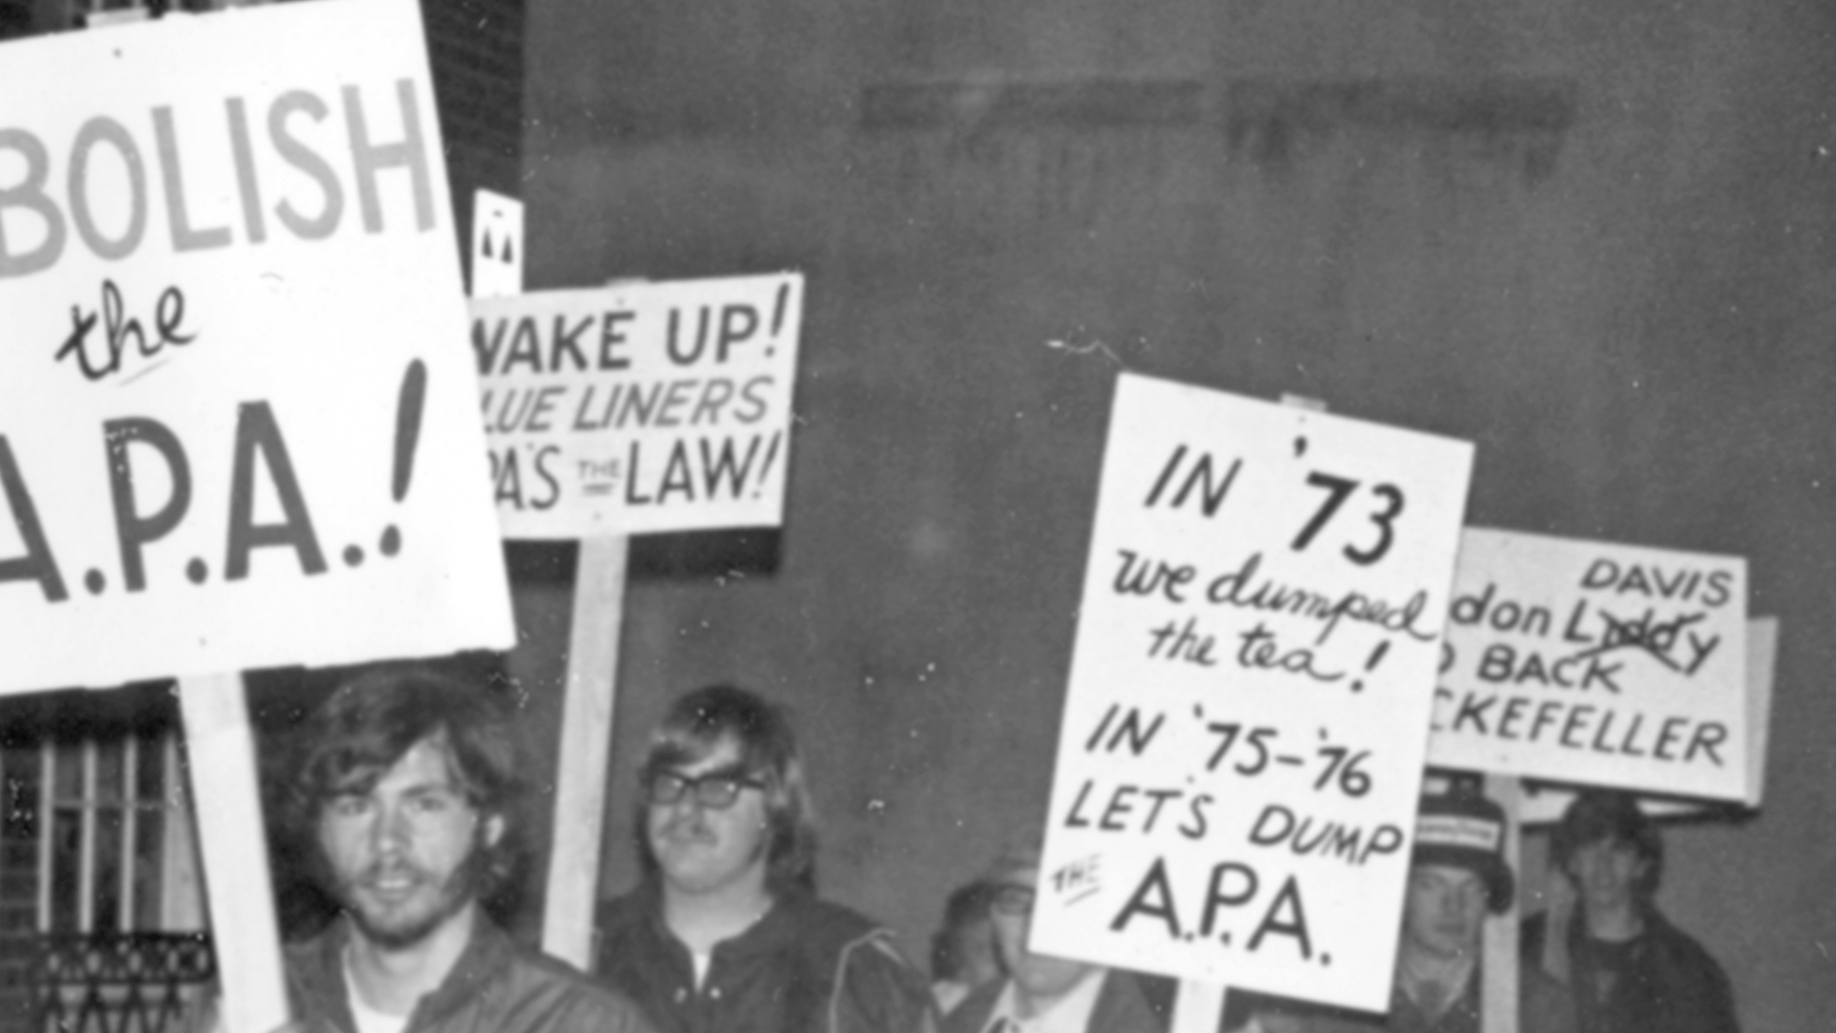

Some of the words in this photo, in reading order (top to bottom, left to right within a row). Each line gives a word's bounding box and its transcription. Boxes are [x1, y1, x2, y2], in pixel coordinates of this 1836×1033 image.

[54, 279, 198, 381] the
[666, 282, 790, 365] UP!
[571, 375, 776, 432] LINERS
[624, 430, 782, 505] LAW!
[1142, 443, 1244, 518] IN
[1289, 433, 1406, 566] '73
[1112, 549, 1196, 602] we
[1206, 551, 1439, 646] dumped
[1580, 557, 1733, 608] DAVIS
[1147, 616, 1220, 667] the
[1477, 643, 1625, 694] BACK
[1084, 702, 1165, 757] IN
[1064, 778, 1215, 840] LET'S
[1248, 803, 1404, 866] DUMP
[1108, 855, 1332, 968] A.P.A.
